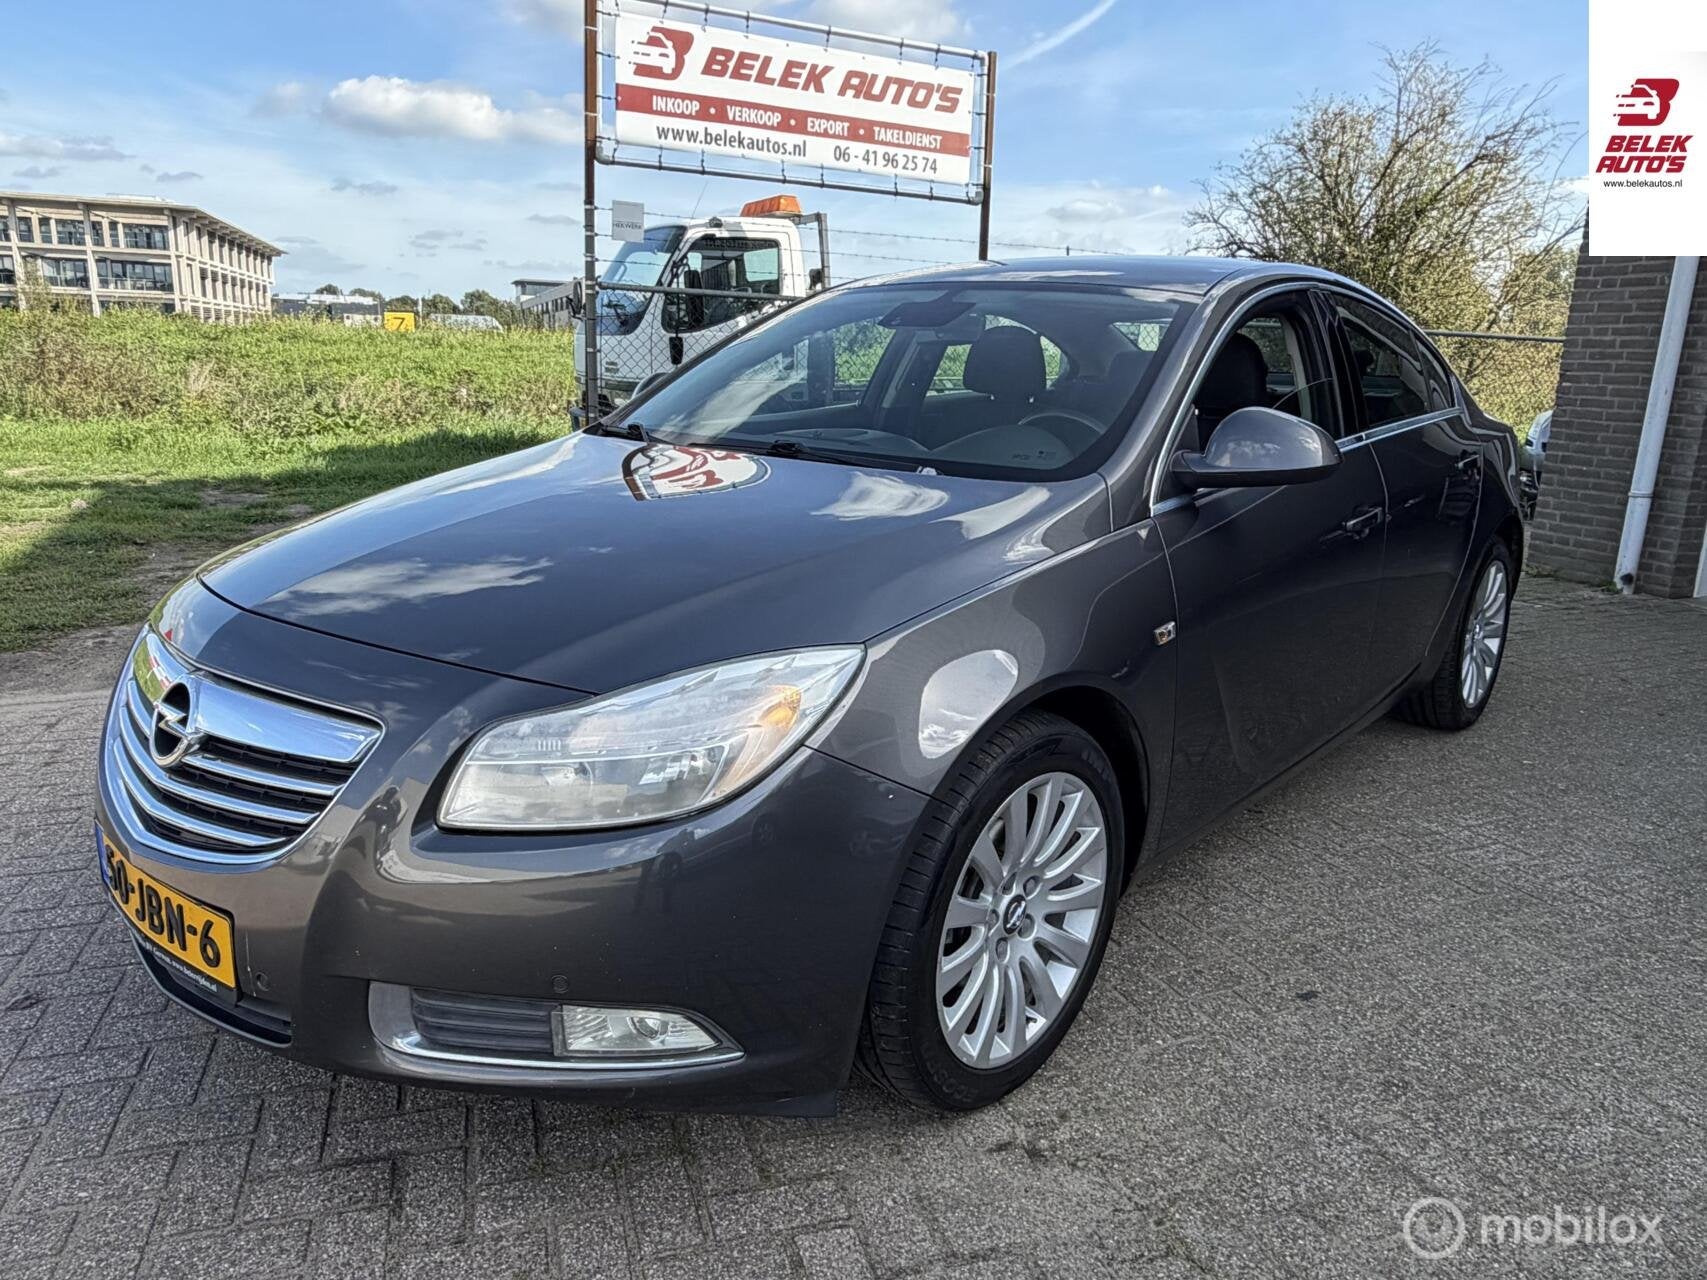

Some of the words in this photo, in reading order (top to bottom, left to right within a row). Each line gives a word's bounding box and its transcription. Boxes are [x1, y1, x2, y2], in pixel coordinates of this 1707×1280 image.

[701, 46, 834, 93] BELEK
[838, 69, 963, 114] AUTO'S
[652, 95, 701, 117] INKOOP
[726, 105, 782, 127] VERKOOP
[807, 117, 850, 137] EXPORT
[873, 126, 942, 150] TAKELDIENST
[656, 125, 807, 158] www.belekautos.nl
[833, 145, 851, 162] 06
